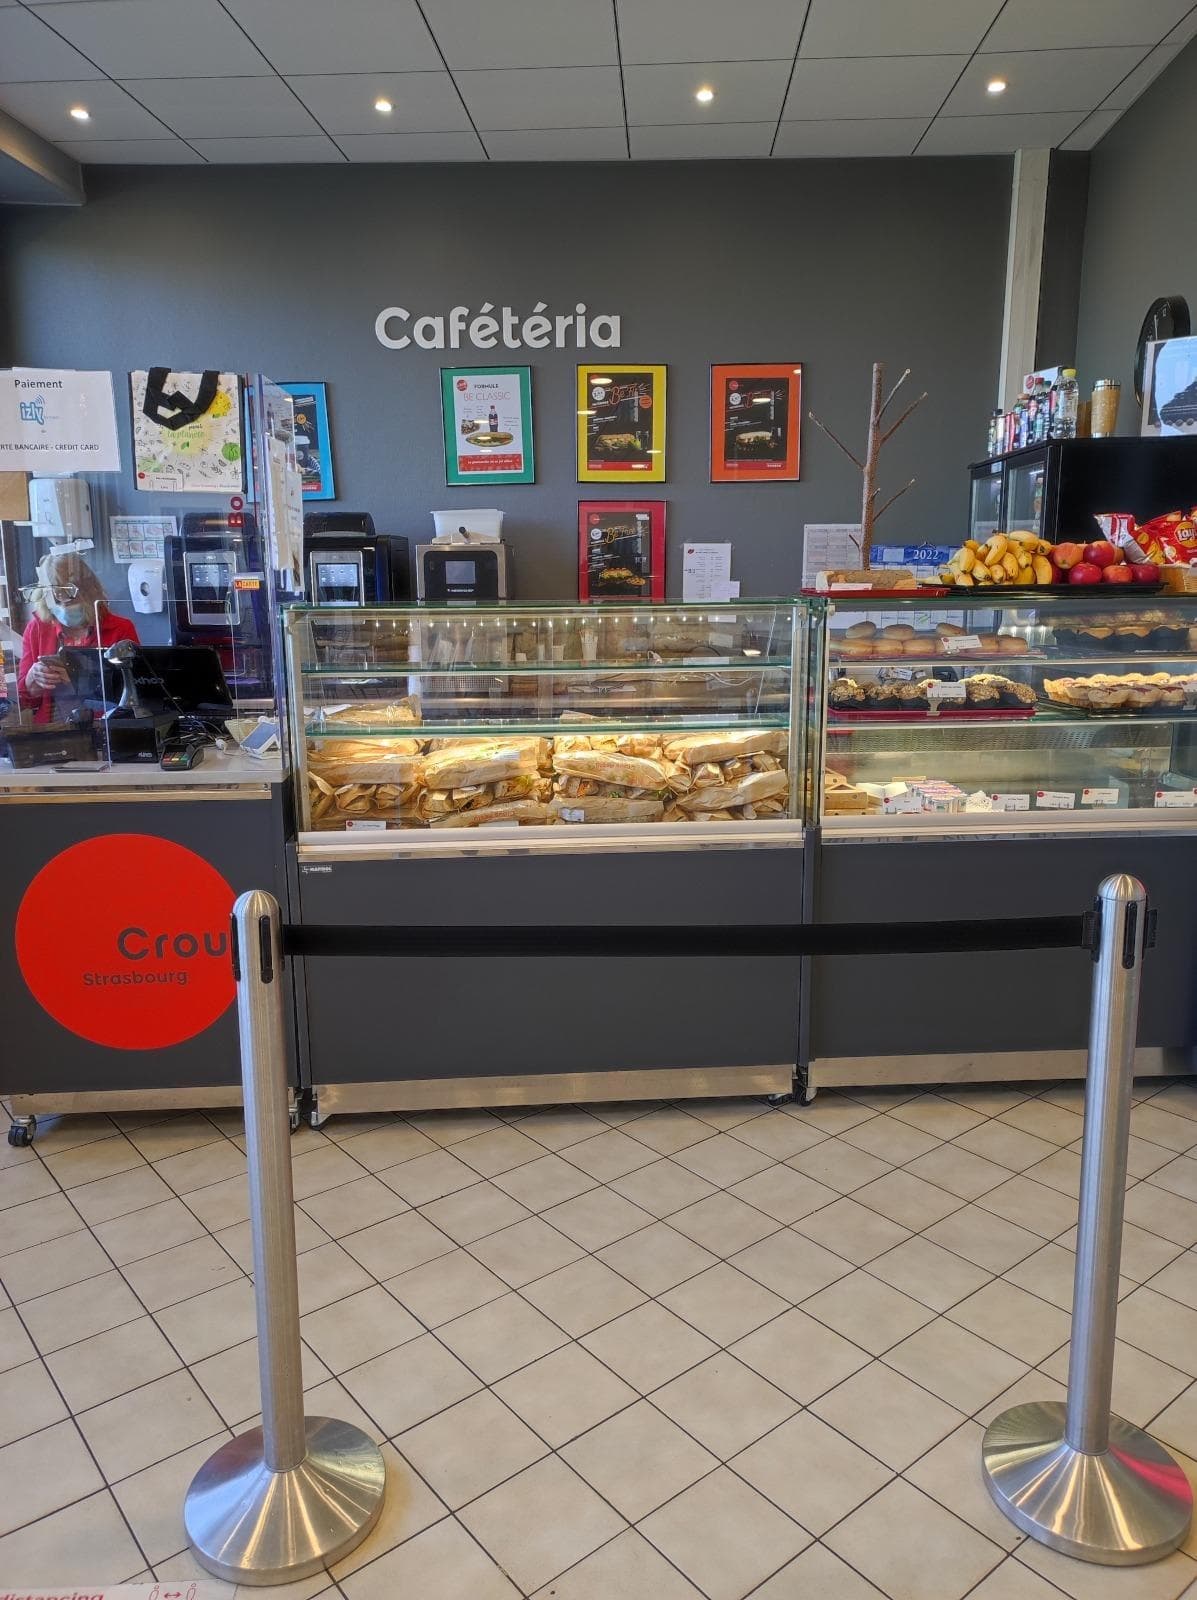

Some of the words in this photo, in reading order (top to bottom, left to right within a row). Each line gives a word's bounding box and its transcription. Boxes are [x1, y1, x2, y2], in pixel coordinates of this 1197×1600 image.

[375, 301, 621, 350] Cafétéria
[14, 379, 63, 389] Paiement
[20, 402, 44, 425] izly
[913, 549, 939, 560] 2022
[83, 971, 188, 986] Strasbourg
